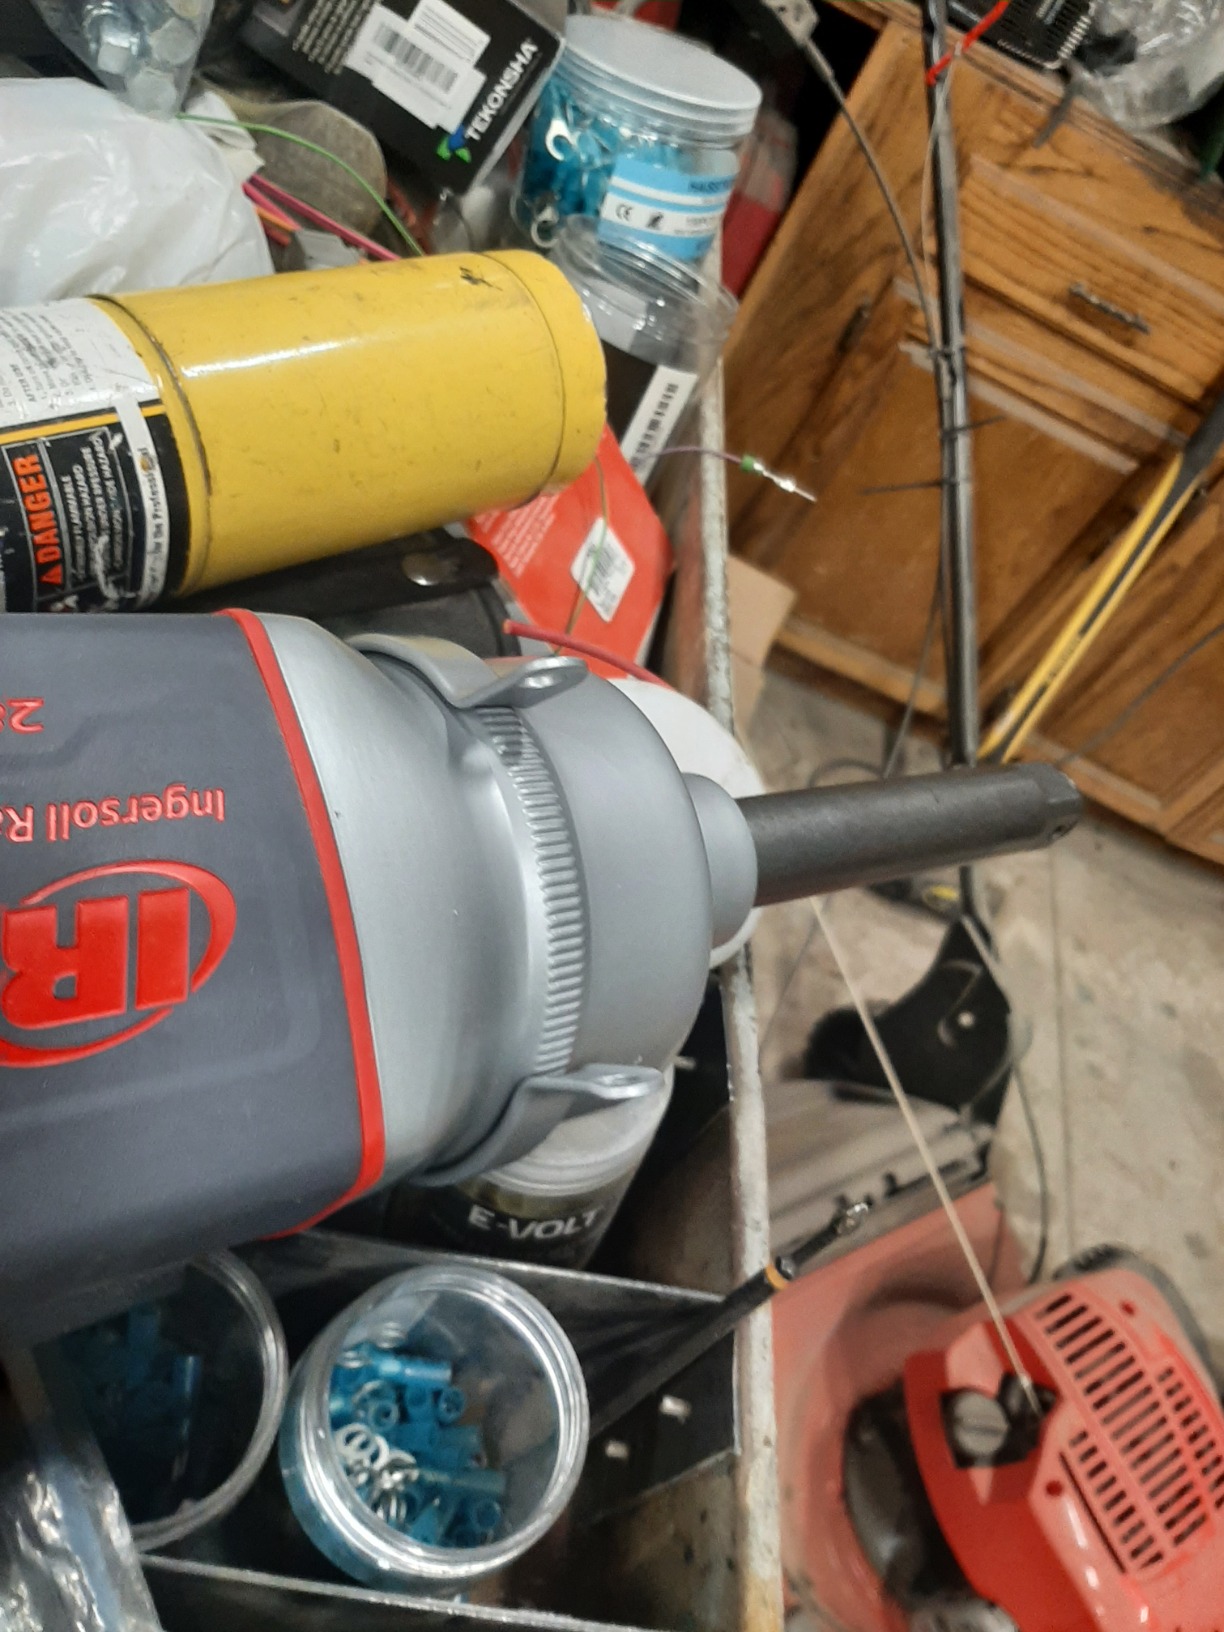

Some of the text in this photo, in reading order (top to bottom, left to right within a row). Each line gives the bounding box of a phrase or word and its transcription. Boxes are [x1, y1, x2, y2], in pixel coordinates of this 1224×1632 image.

[464, 43, 539, 140] TEKONSHA
[12, 454, 62, 564] DANGER
[0, 697, 45, 734] 2
[0, 783, 226, 843] Ingersoll R
[2, 887, 190, 1030] IR
[468, 1204, 605, 1240] E-VOLT
